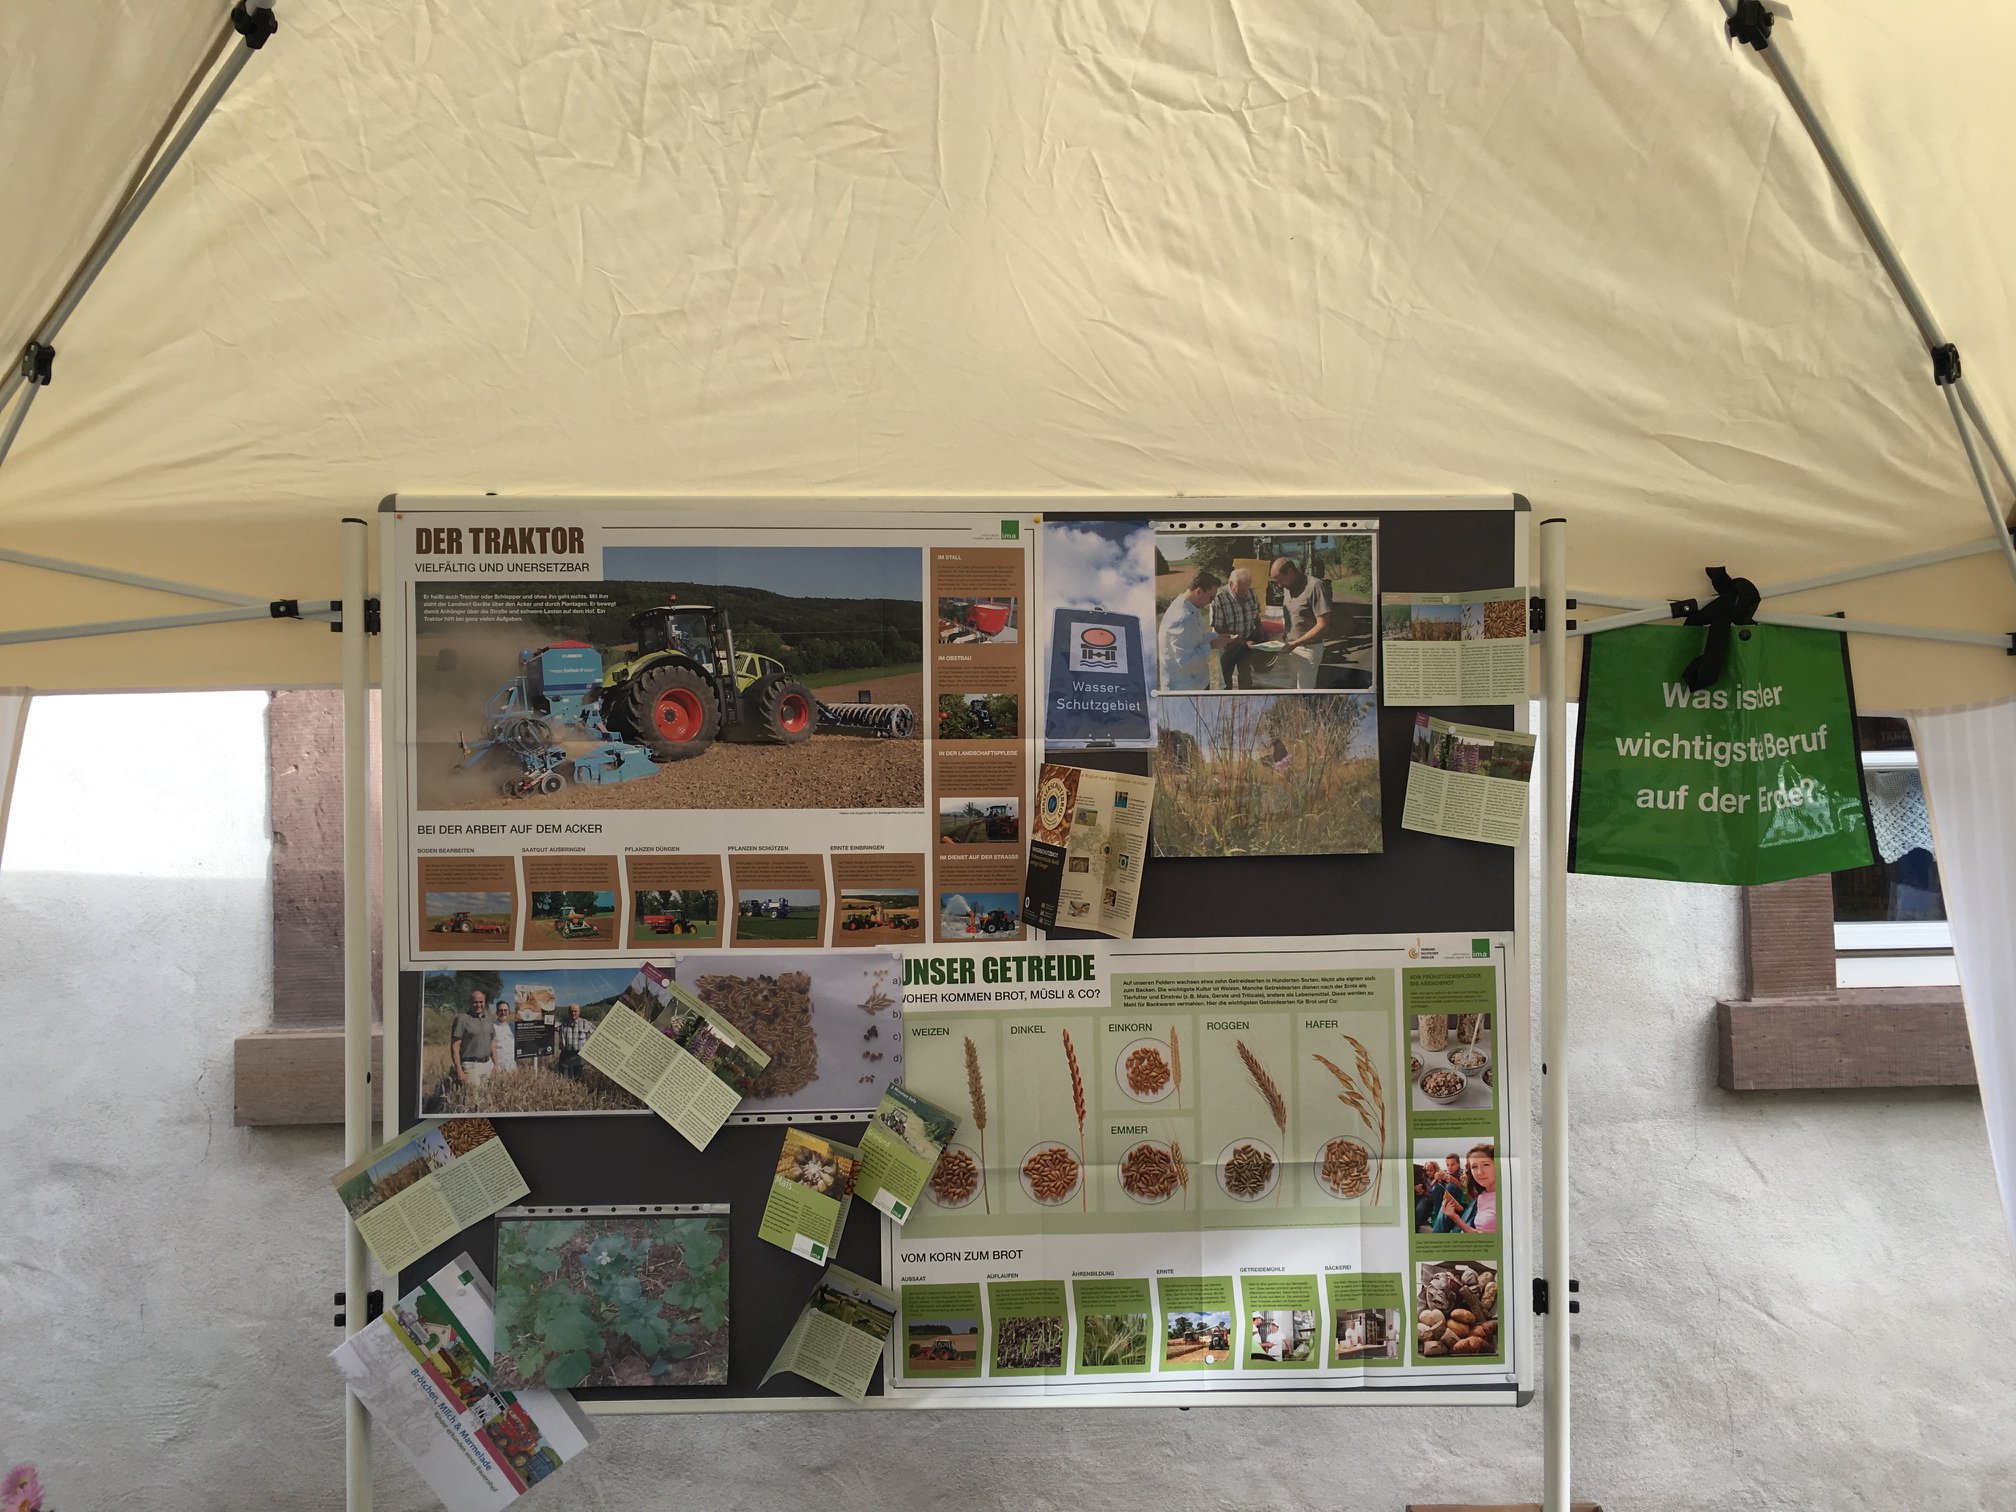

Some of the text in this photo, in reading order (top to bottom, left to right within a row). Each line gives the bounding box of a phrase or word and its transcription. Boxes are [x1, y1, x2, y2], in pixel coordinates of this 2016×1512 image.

[416, 527, 584, 554] DER TRAKTOR
[415, 561, 589, 572] VIELFÄLTIG UND UNERSETZBAR
[1073, 681, 1125, 692] Wasser-
[1663, 683, 1728, 709] Was
[1757, 683, 1782, 708] der
[1056, 699, 1140, 713] Schutzgebiet
[1616, 724, 1828, 767] wichtigste Beruf
[1636, 778, 1814, 814] auf der Erde?
[418, 824, 602, 834] BEI DER ARBEIT AUF DEM ACKER
[903, 955, 1095, 986] UNSER GETREIDE
[893, 977, 901, 986] a)
[941, 992, 991, 1002] KOMMEN
[996, 991, 1027, 1001] BROT,
[1030, 988, 1064, 1000] MÜSLI
[1080, 989, 1100, 998] CO?
[893, 1010, 901, 1020] b)
[1011, 1026, 1045, 1034] DINKEL
[1109, 1024, 1152, 1032] EINKORN
[1207, 1022, 1249, 1030] ROGGEN
[893, 1033, 901, 1041] c)
[894, 1054, 902, 1063] d)
[894, 1076, 902, 1085] e)
[1111, 1126, 1147, 1134] EMMER
[774, 1177, 792, 1190] Mais
[901, 1250, 1023, 1262] VOM KORN ZUM BROT
[411, 1368, 492, 1471] Brötchen, Milch & Marmelade
